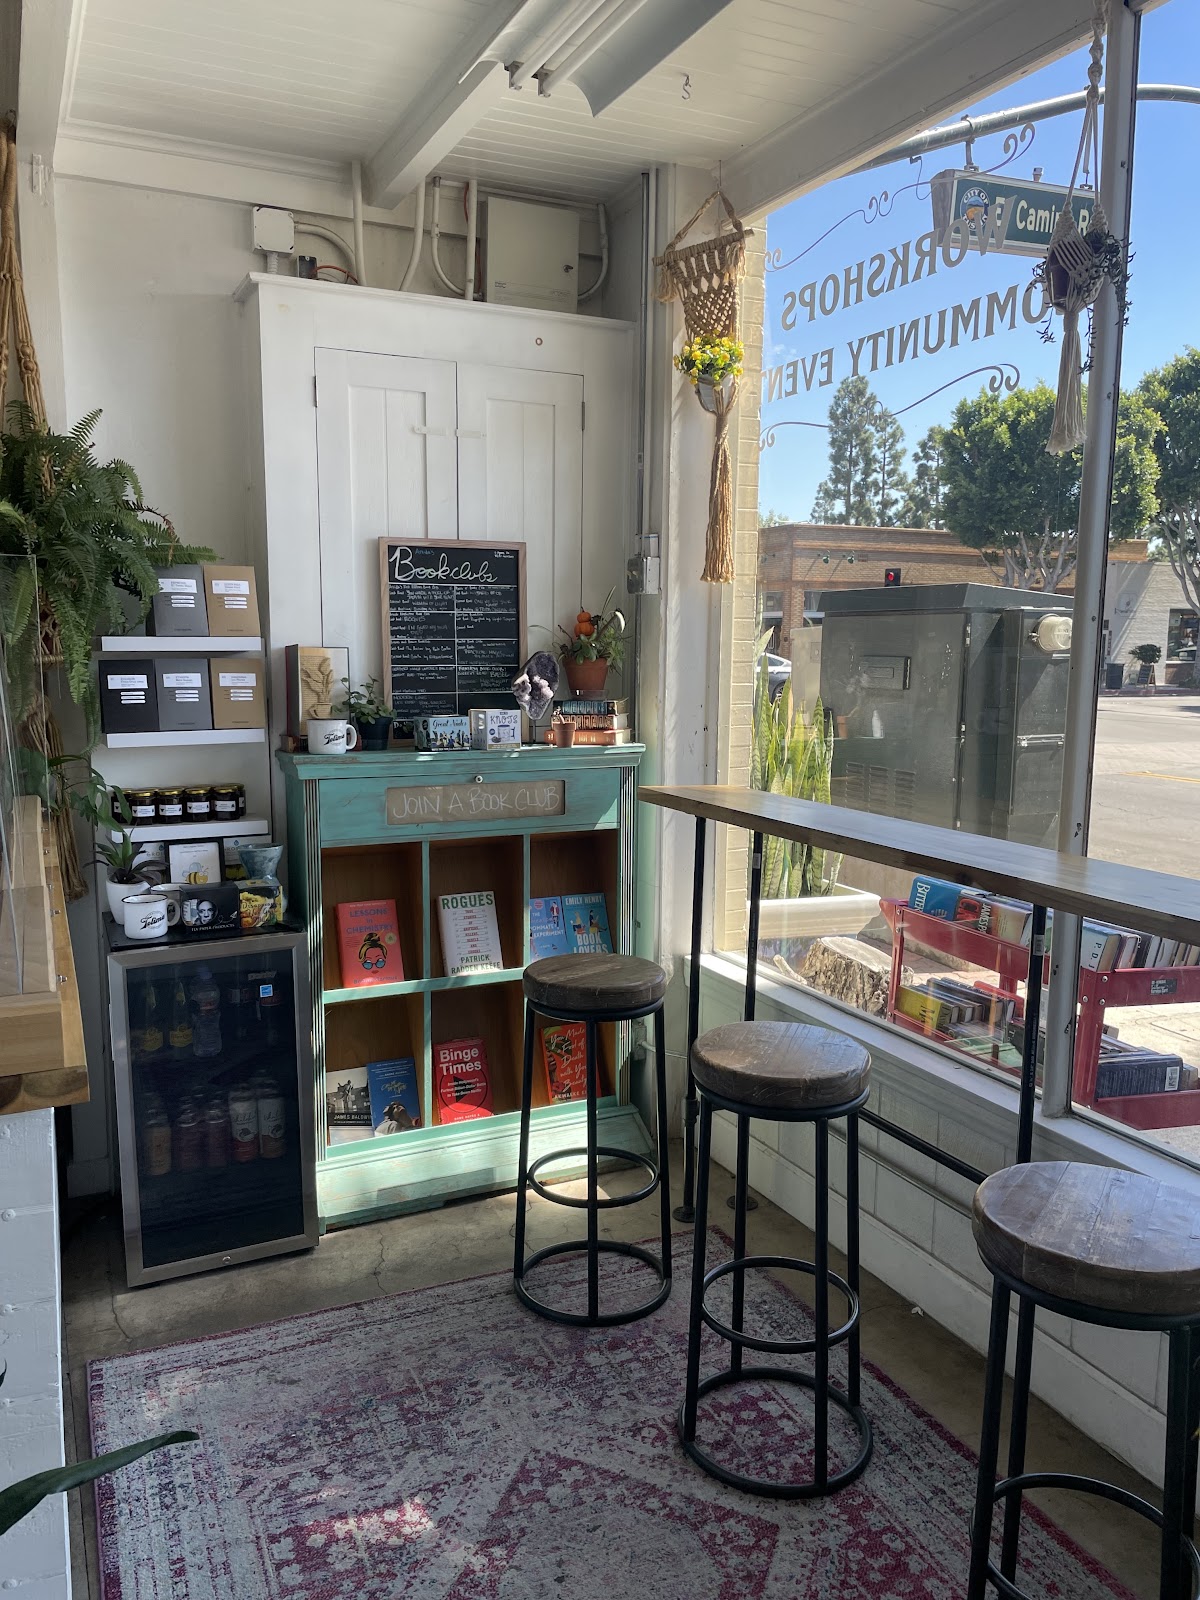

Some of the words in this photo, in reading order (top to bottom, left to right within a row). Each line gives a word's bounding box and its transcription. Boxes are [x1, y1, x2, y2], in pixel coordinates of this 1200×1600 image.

[1016, 200, 1063, 234] Camin
[393, 794, 440, 818] JOIN
[448, 792, 463, 813] A
[468, 787, 513, 814] BOOK
[515, 786, 559, 811] CLUB
[442, 893, 494, 910] ROGUES
[565, 896, 584, 906] EMILY
[349, 907, 388, 918] LESSONS
[346, 924, 393, 935] CHEMISTRY
[533, 930, 564, 938] EXPERIMENT
[576, 932, 603, 946] BOOK
[460, 954, 491, 964] PATRICK
[451, 963, 480, 975] RADDEN
[480, 961, 501, 971] KEEFE
[440, 1047, 479, 1062] Binge
[440, 1061, 482, 1076] Times
